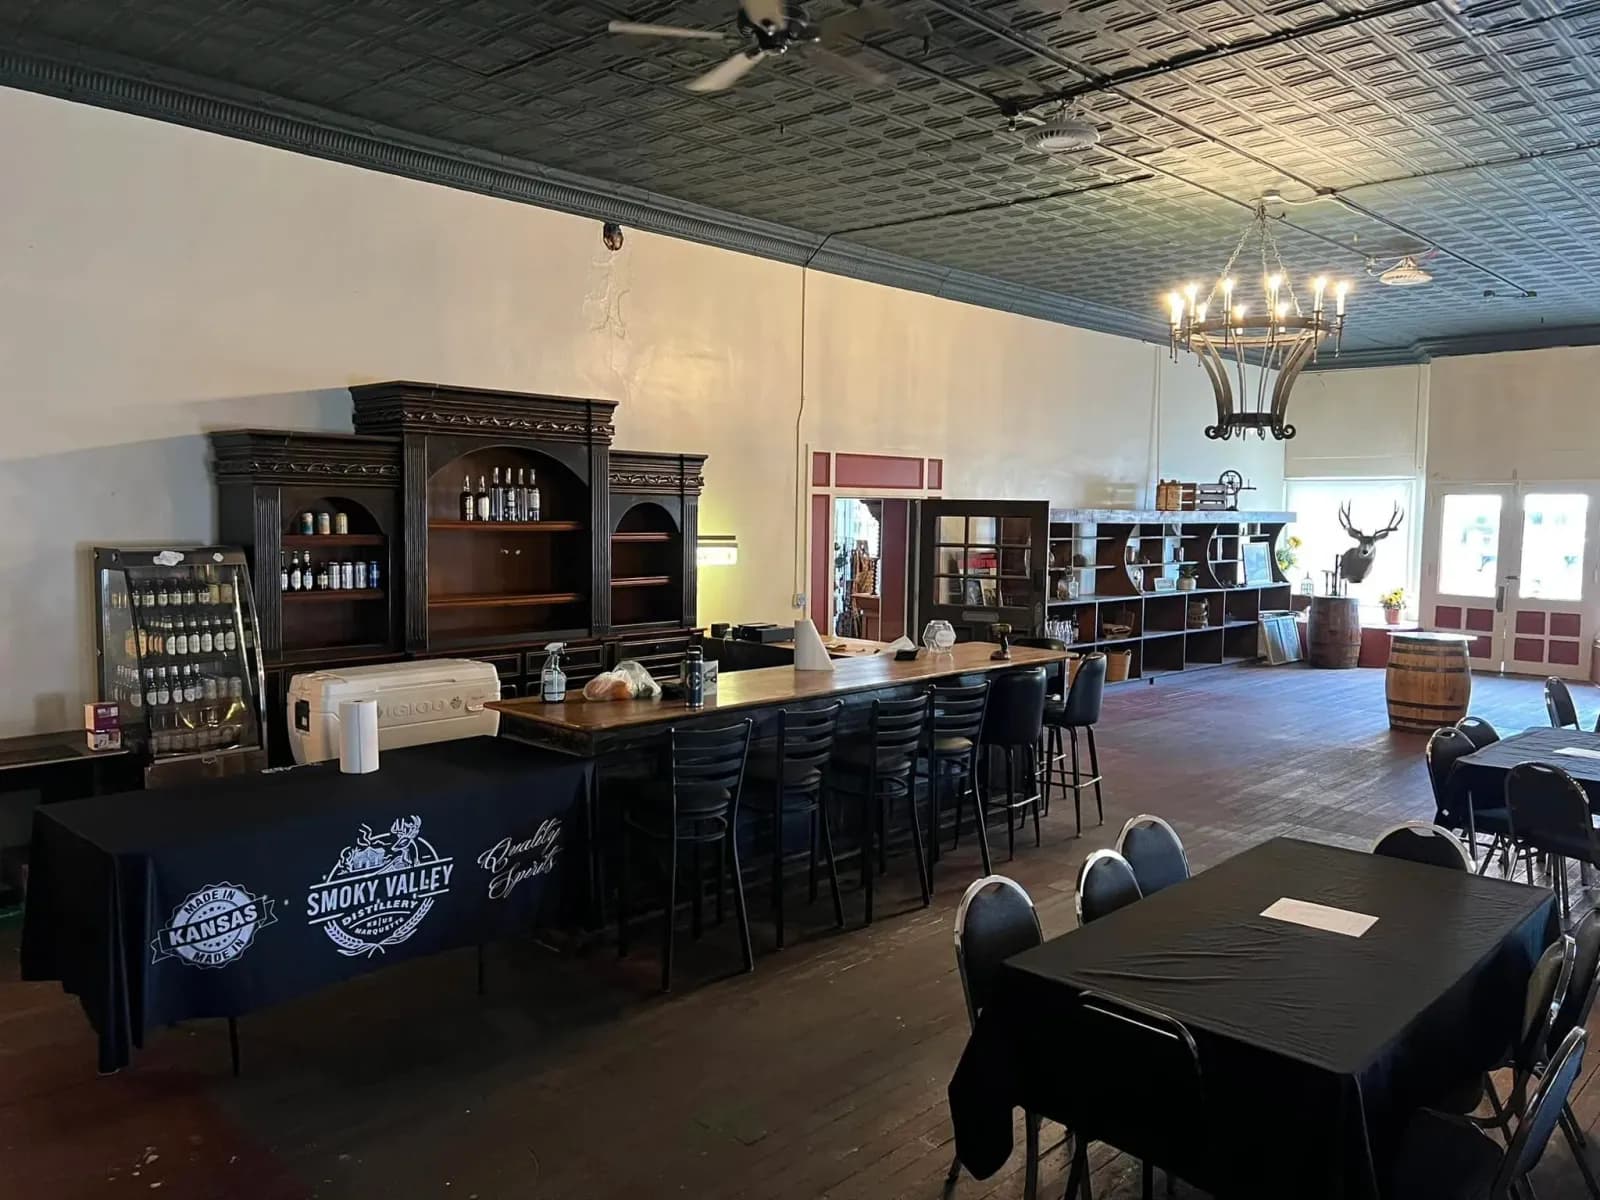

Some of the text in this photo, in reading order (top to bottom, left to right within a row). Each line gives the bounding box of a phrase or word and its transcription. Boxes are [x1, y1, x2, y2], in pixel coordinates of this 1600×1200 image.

[477, 816, 562, 873] Quality
[306, 863, 454, 916] SMOKY VALLEY
[488, 845, 562, 900] Spirits
[184, 889, 236, 915] MADE IN
[341, 899, 419, 927] DISTILLERY
[168, 904, 258, 946] KANSAS
[354, 917, 405, 936] MARQUETTE
[192, 938, 246, 964] MADE IN
